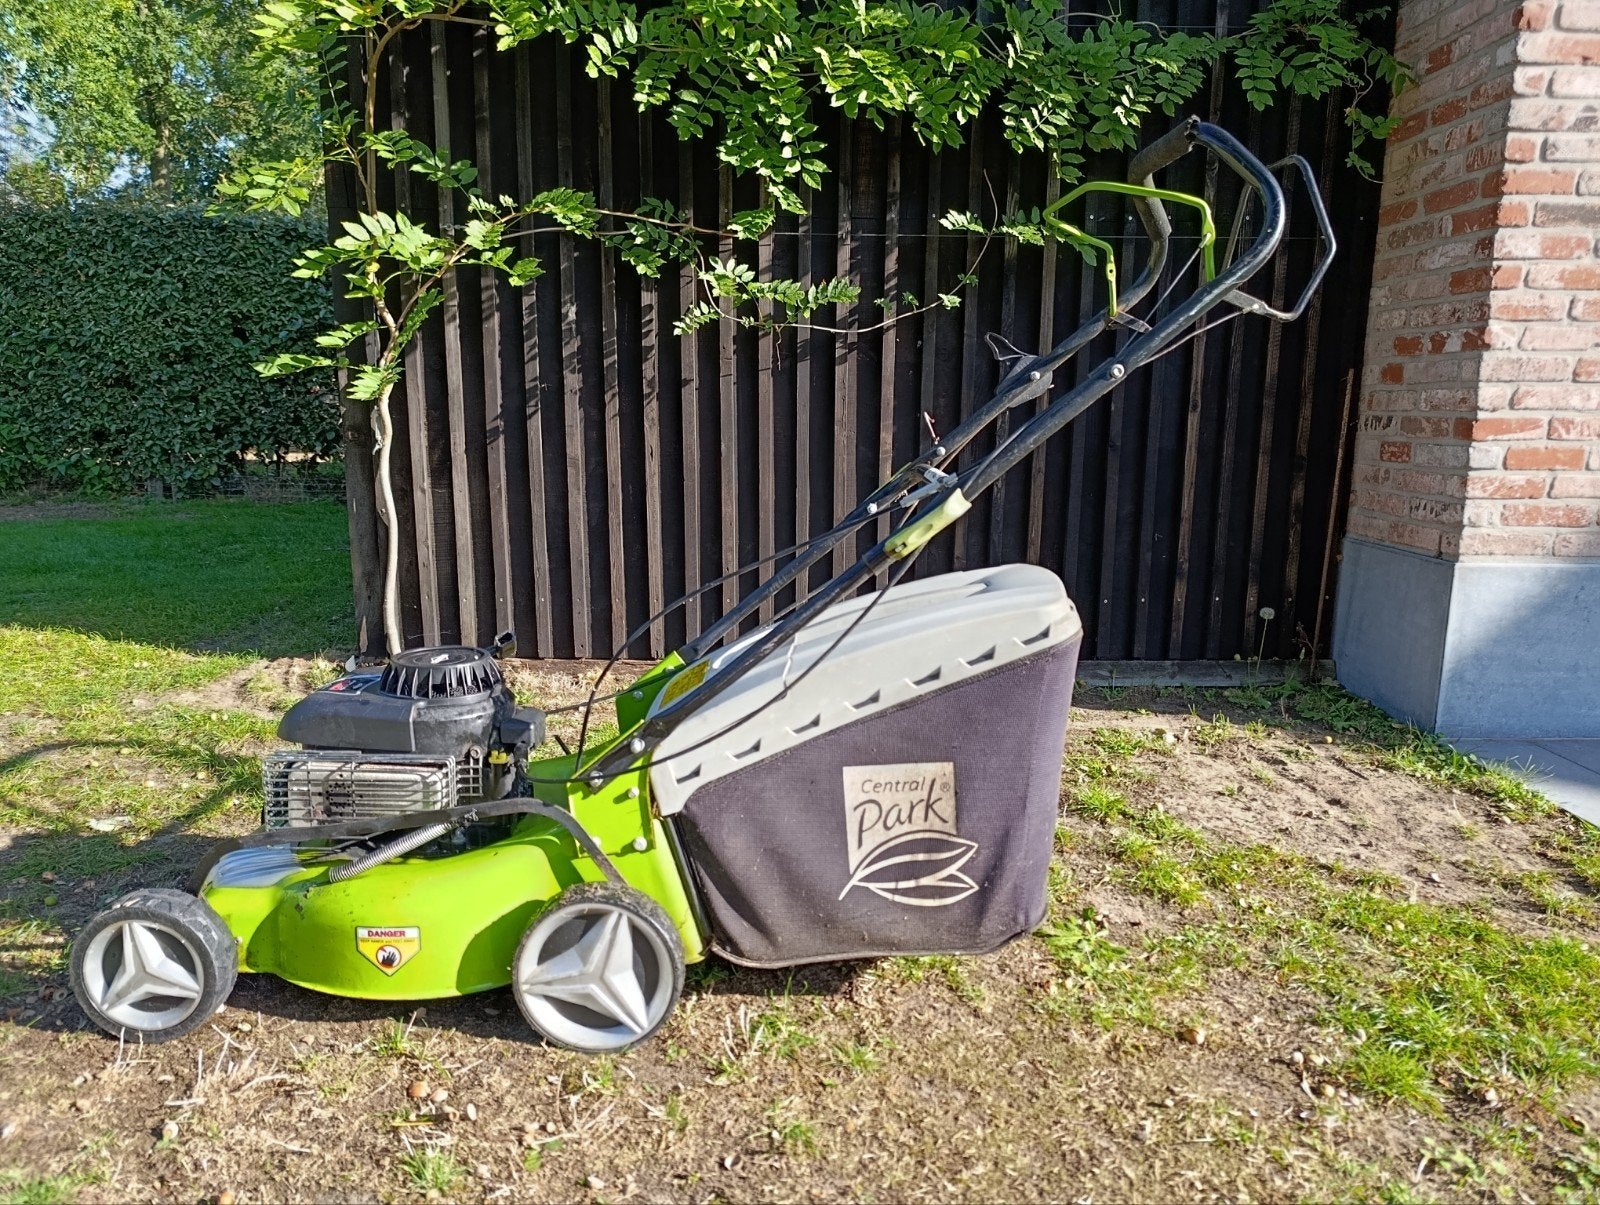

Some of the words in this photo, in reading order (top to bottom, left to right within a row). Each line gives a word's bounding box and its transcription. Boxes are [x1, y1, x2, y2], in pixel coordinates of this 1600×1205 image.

[861, 776, 926, 794] Central
[853, 778, 949, 850] Park
[367, 930, 406, 938] DANGER
